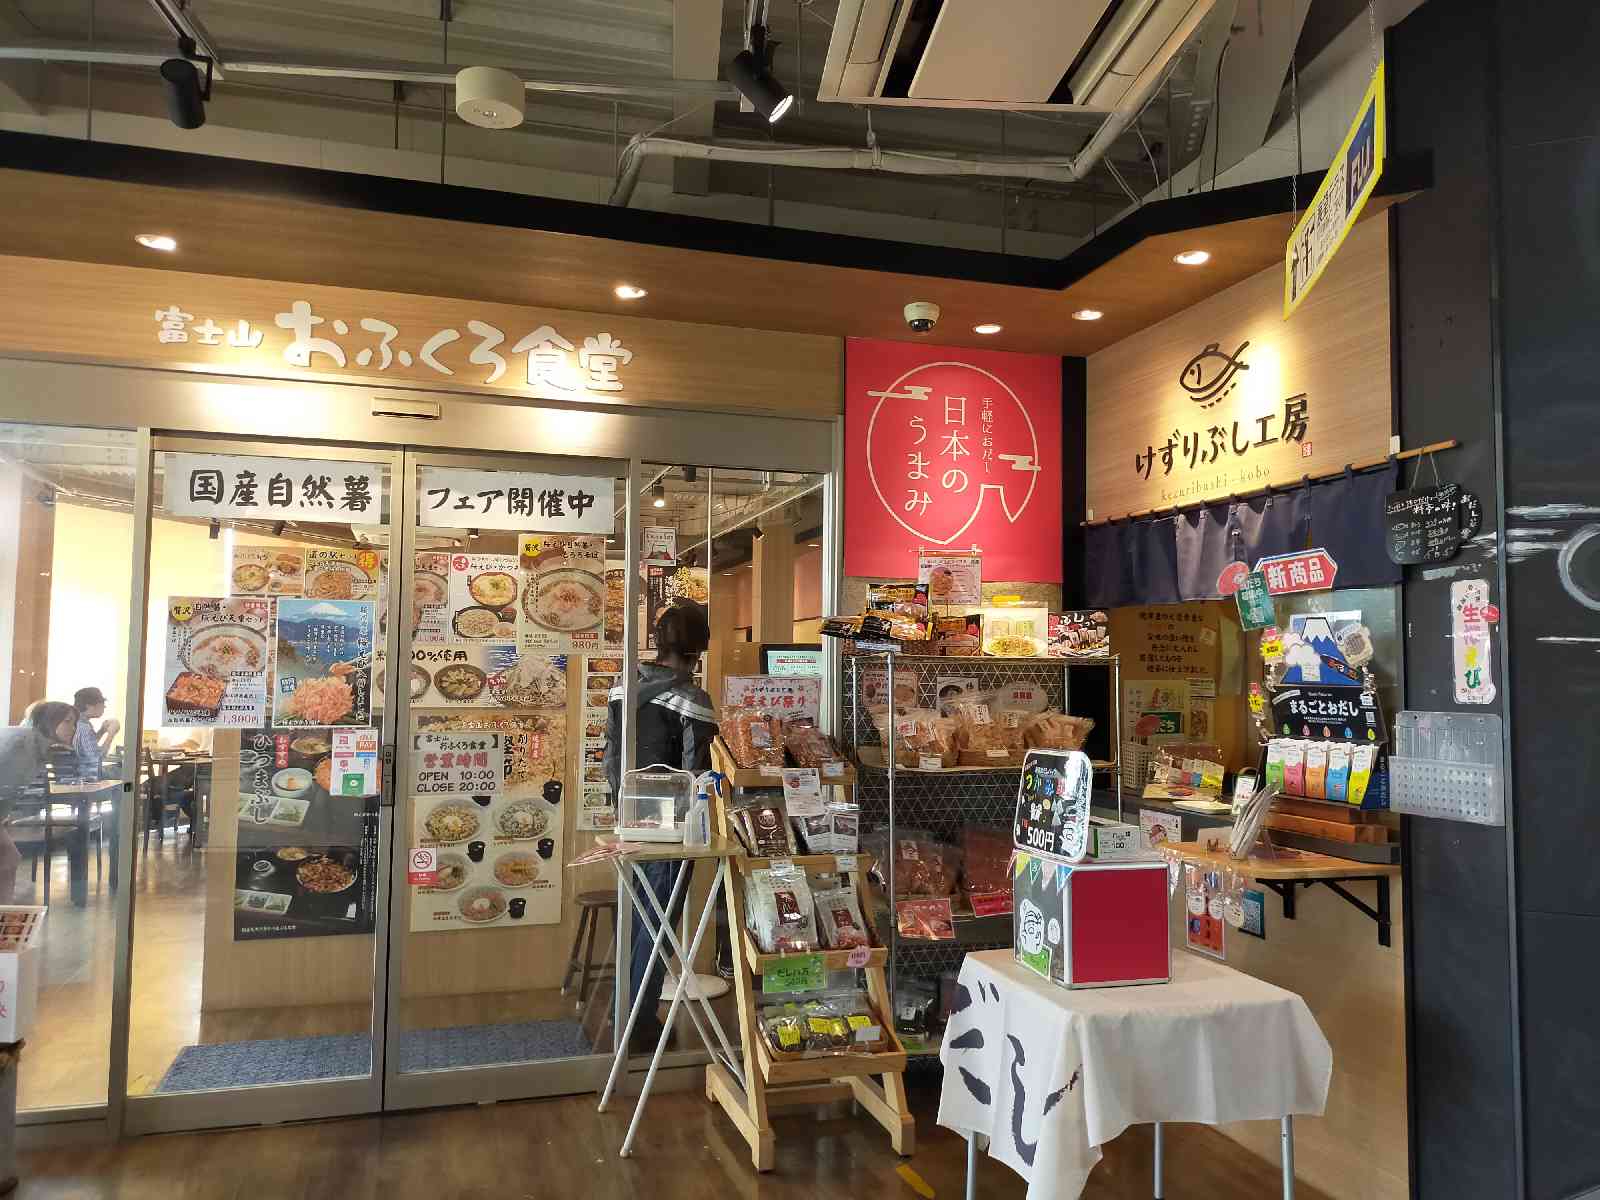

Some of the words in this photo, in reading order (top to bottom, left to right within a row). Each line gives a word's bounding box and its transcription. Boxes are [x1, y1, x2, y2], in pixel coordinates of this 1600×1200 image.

[154, 305, 264, 348] 富士山
[274, 300, 634, 393] おふくろ食堂
[939, 395, 970, 493] 日本の
[1135, 391, 1312, 482] けずりぶし工房
[904, 415, 933, 517] うまみ
[189, 469, 373, 514] 国産自然薯
[426, 486, 596, 519] フェア開催中
[1267, 559, 1325, 589] 新商品
[1290, 700, 1359, 717] まるごとおだし
[418, 771, 449, 781] OPEN
[460, 770, 495, 780] 10:00
[424, 752, 488, 768] 営業時間
[416, 783, 455, 793] CLOSE
[459, 782, 496, 792] 20:00
[1027, 826, 1055, 852] 500円
